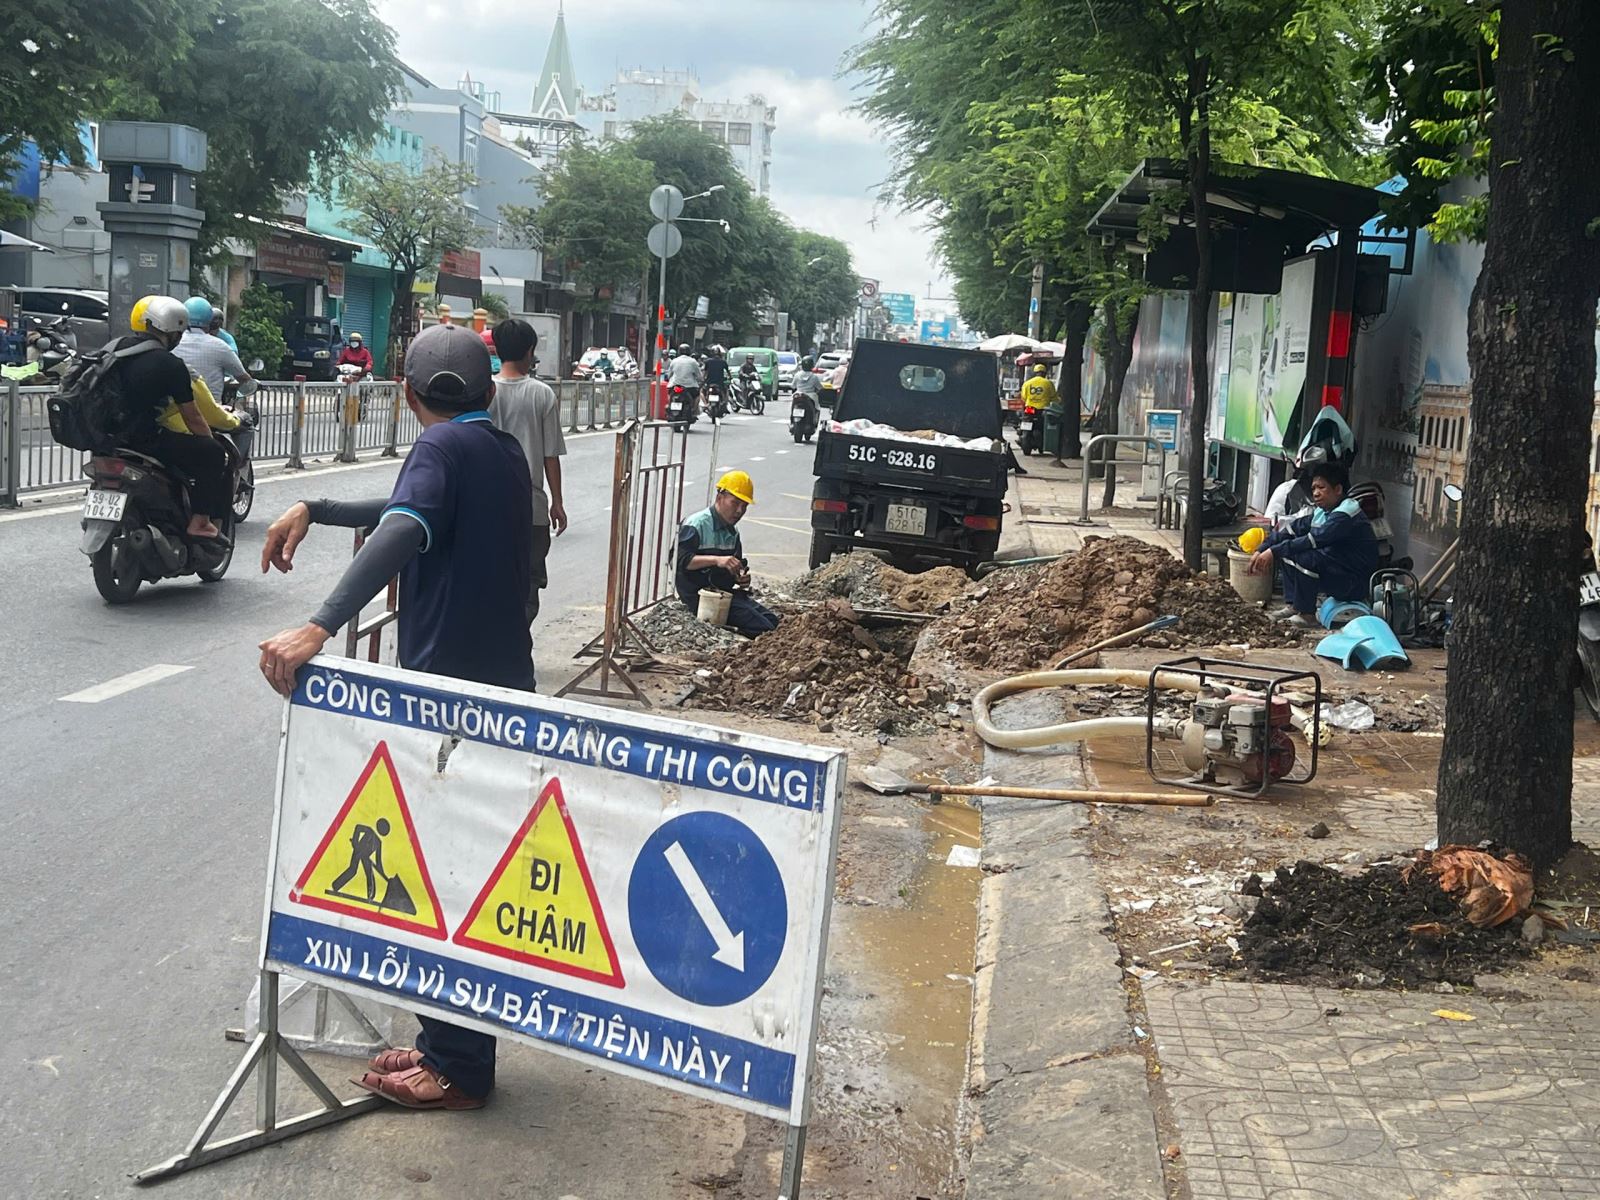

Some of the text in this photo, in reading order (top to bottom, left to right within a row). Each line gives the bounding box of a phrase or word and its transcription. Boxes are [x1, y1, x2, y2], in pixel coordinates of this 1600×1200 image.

[1030, 383, 1043, 396] be
[849, 444, 876, 462] 51C
[897, 506, 917, 520] 51C
[306, 673, 808, 803] CÔNG TRƯỜNG ĐANG THI CÔNG
[531, 858, 561, 895] ĐI
[496, 902, 586, 955] CHẬM
[304, 937, 352, 974] XIN
[359, 946, 409, 988] LỖI
[417, 964, 445, 999] VÌ
[500, 989, 567, 1036] BẤT
[576, 1012, 650, 1060] TIỆN
[659, 1036, 731, 1084] NÀY
